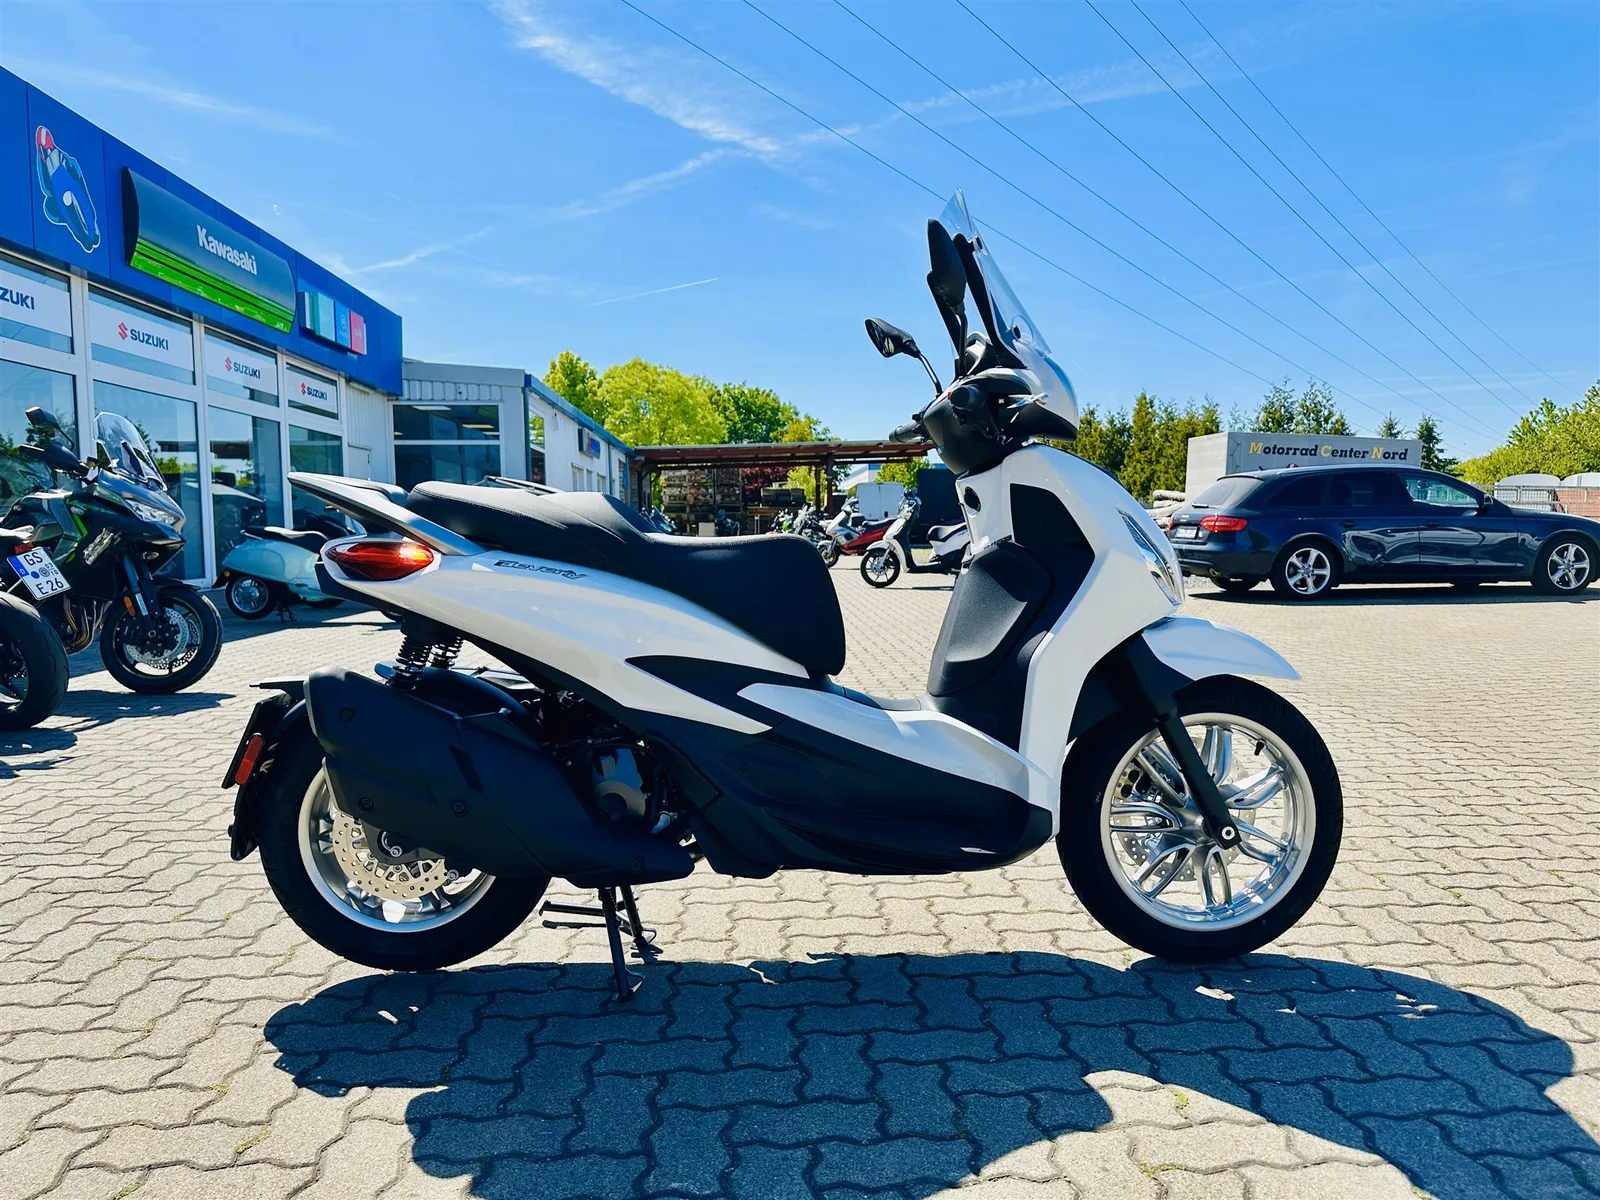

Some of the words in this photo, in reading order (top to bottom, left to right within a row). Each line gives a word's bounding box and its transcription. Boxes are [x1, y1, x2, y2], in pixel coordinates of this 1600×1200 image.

[196, 224, 258, 276] Kawasaki
[129, 328, 169, 351] SUZUKI
[233, 361, 261, 379] SUZUKI
[306, 386, 328, 401] SUZUKI
[1248, 441, 1319, 458] Motorrad
[1319, 444, 1370, 459] Center
[1370, 446, 1409, 461] Nord
[23, 551, 43, 566] GS
[35, 582, 49, 595] E
[45, 577, 64, 592] 26
